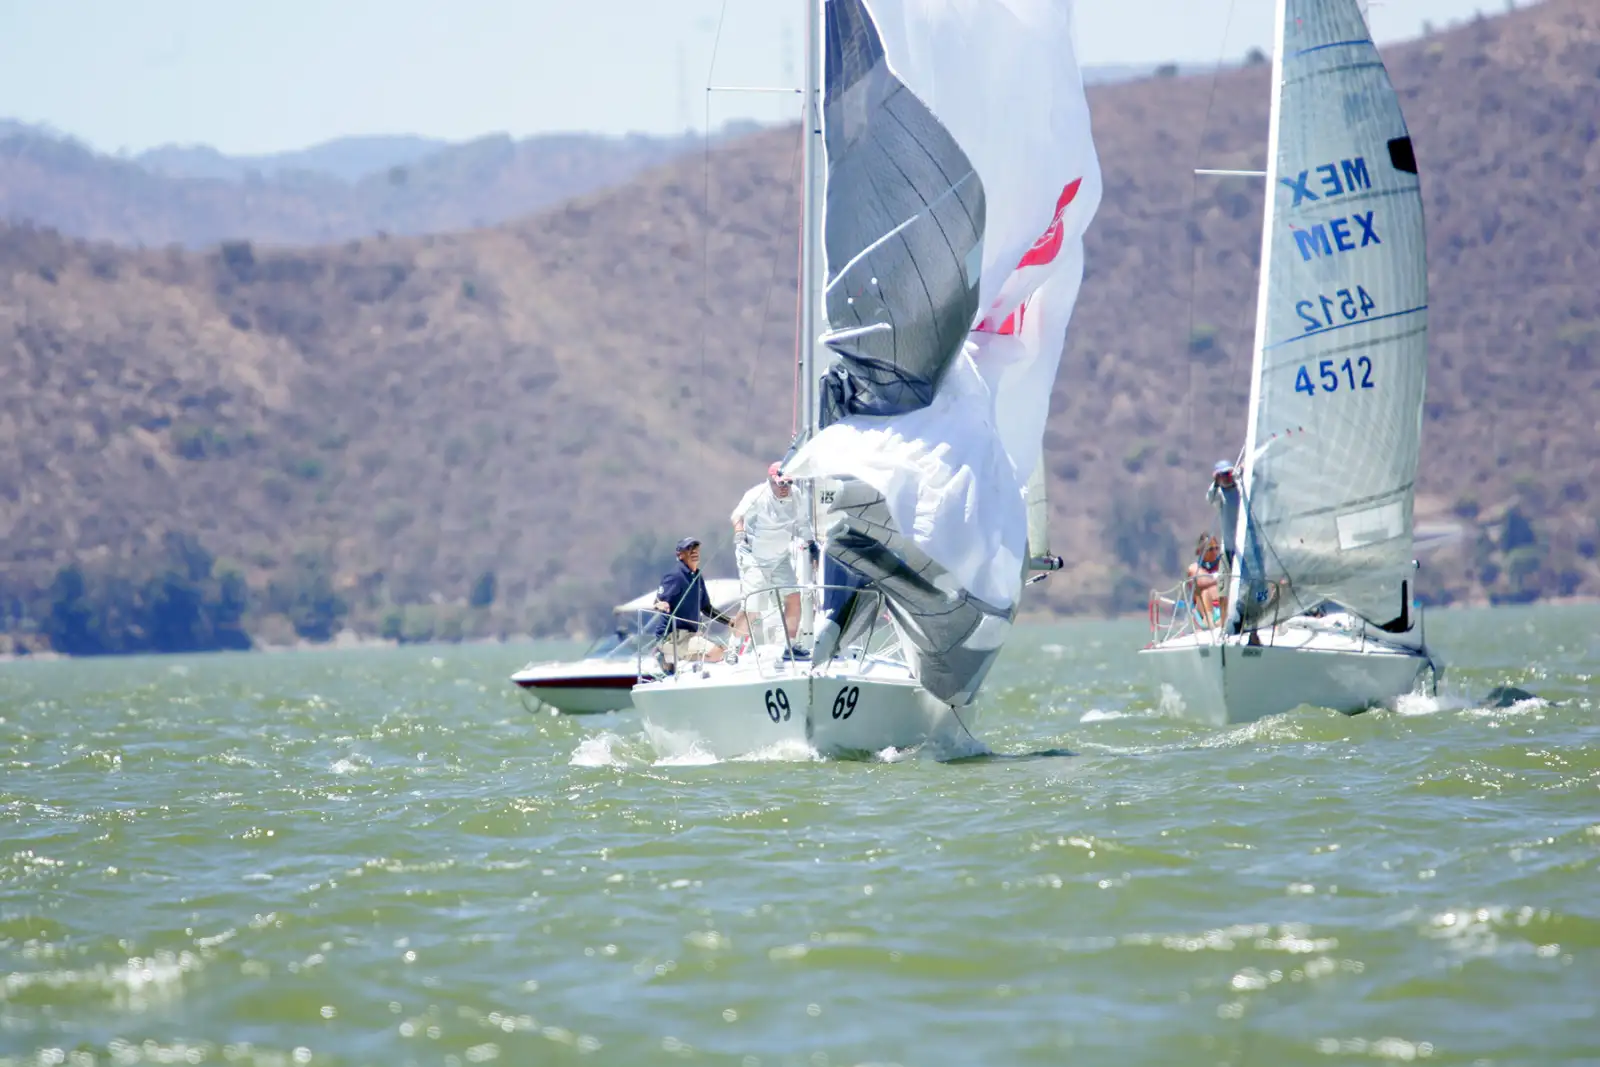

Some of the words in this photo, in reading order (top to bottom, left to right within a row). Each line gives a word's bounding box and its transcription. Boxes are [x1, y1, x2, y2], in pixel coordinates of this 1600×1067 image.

[1292, 211, 1380, 261] MEX
[1295, 356, 1374, 396] 4512
[765, 688, 791, 723] 69
[832, 686, 859, 720] 69
